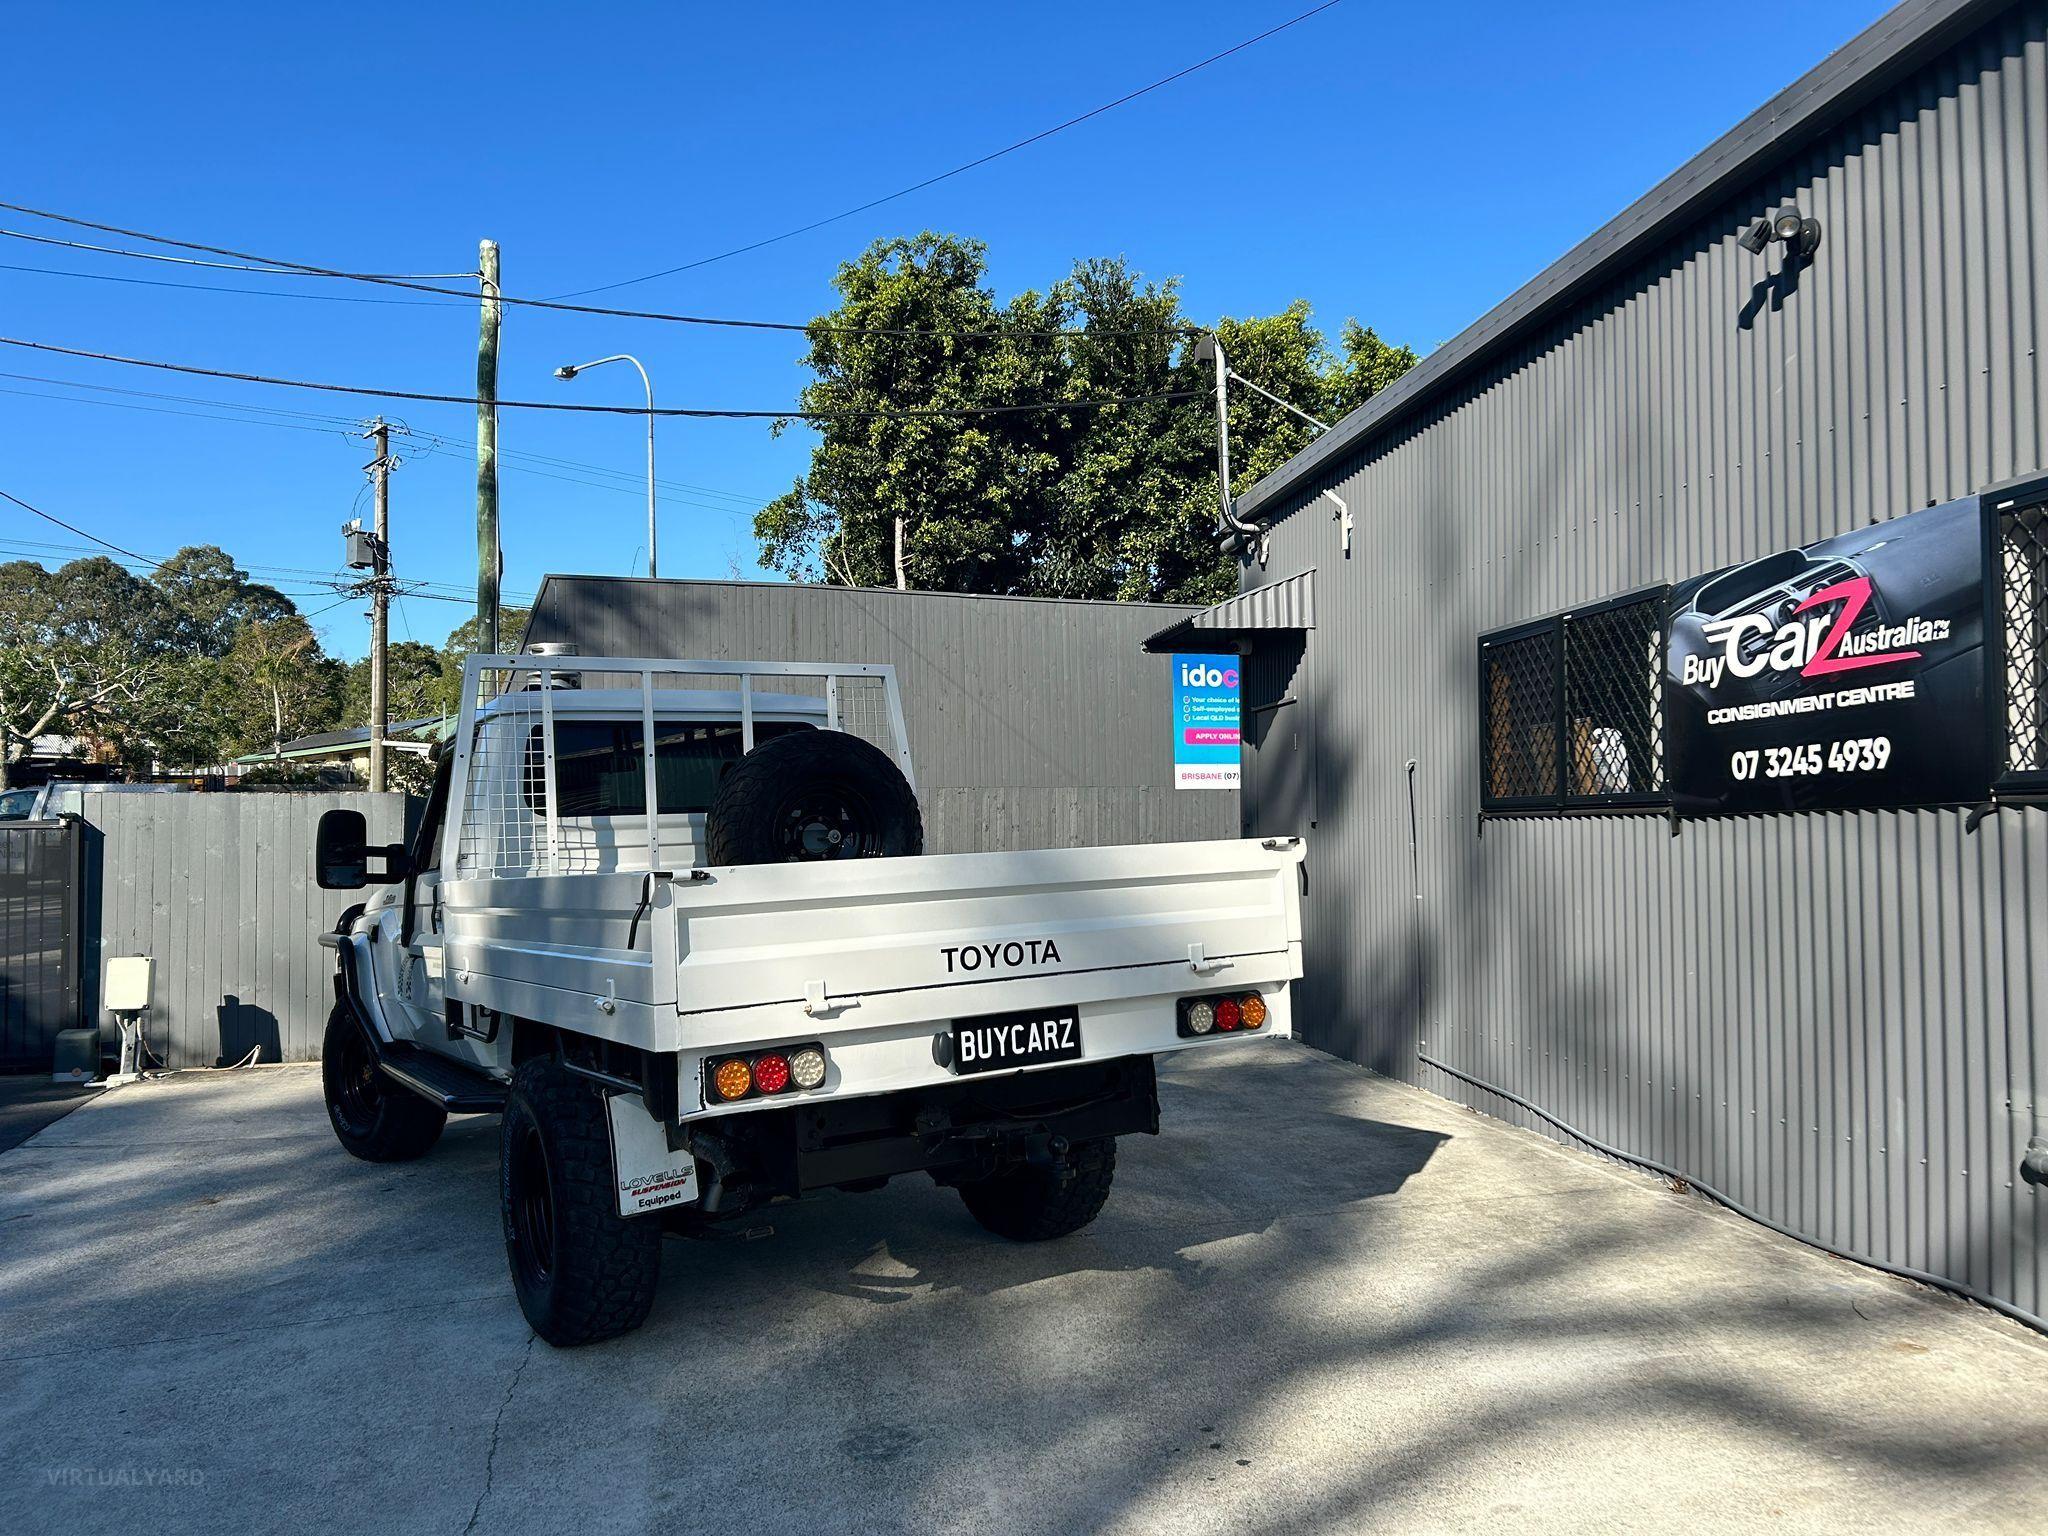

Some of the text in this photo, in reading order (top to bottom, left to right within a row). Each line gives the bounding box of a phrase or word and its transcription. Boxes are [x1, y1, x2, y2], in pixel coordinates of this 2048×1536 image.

[1838, 616, 1933, 658] Australia
[1191, 705, 1236, 714] Self-employed
[1707, 680, 1916, 725] CONSIGNMENT CENTRE
[1210, 714, 1224, 722] QLD
[1731, 736, 1891, 781] 07 3245 4939
[1181, 772, 1240, 780] BRISBANE (07)
[940, 939, 1062, 973] TOYOTA
[960, 1018, 1075, 1062] BUYCARZ
[620, 1165, 695, 1191] LOVELLS
[631, 1178, 687, 1196] SUSPENSION
[638, 1191, 682, 1208] Equipped
